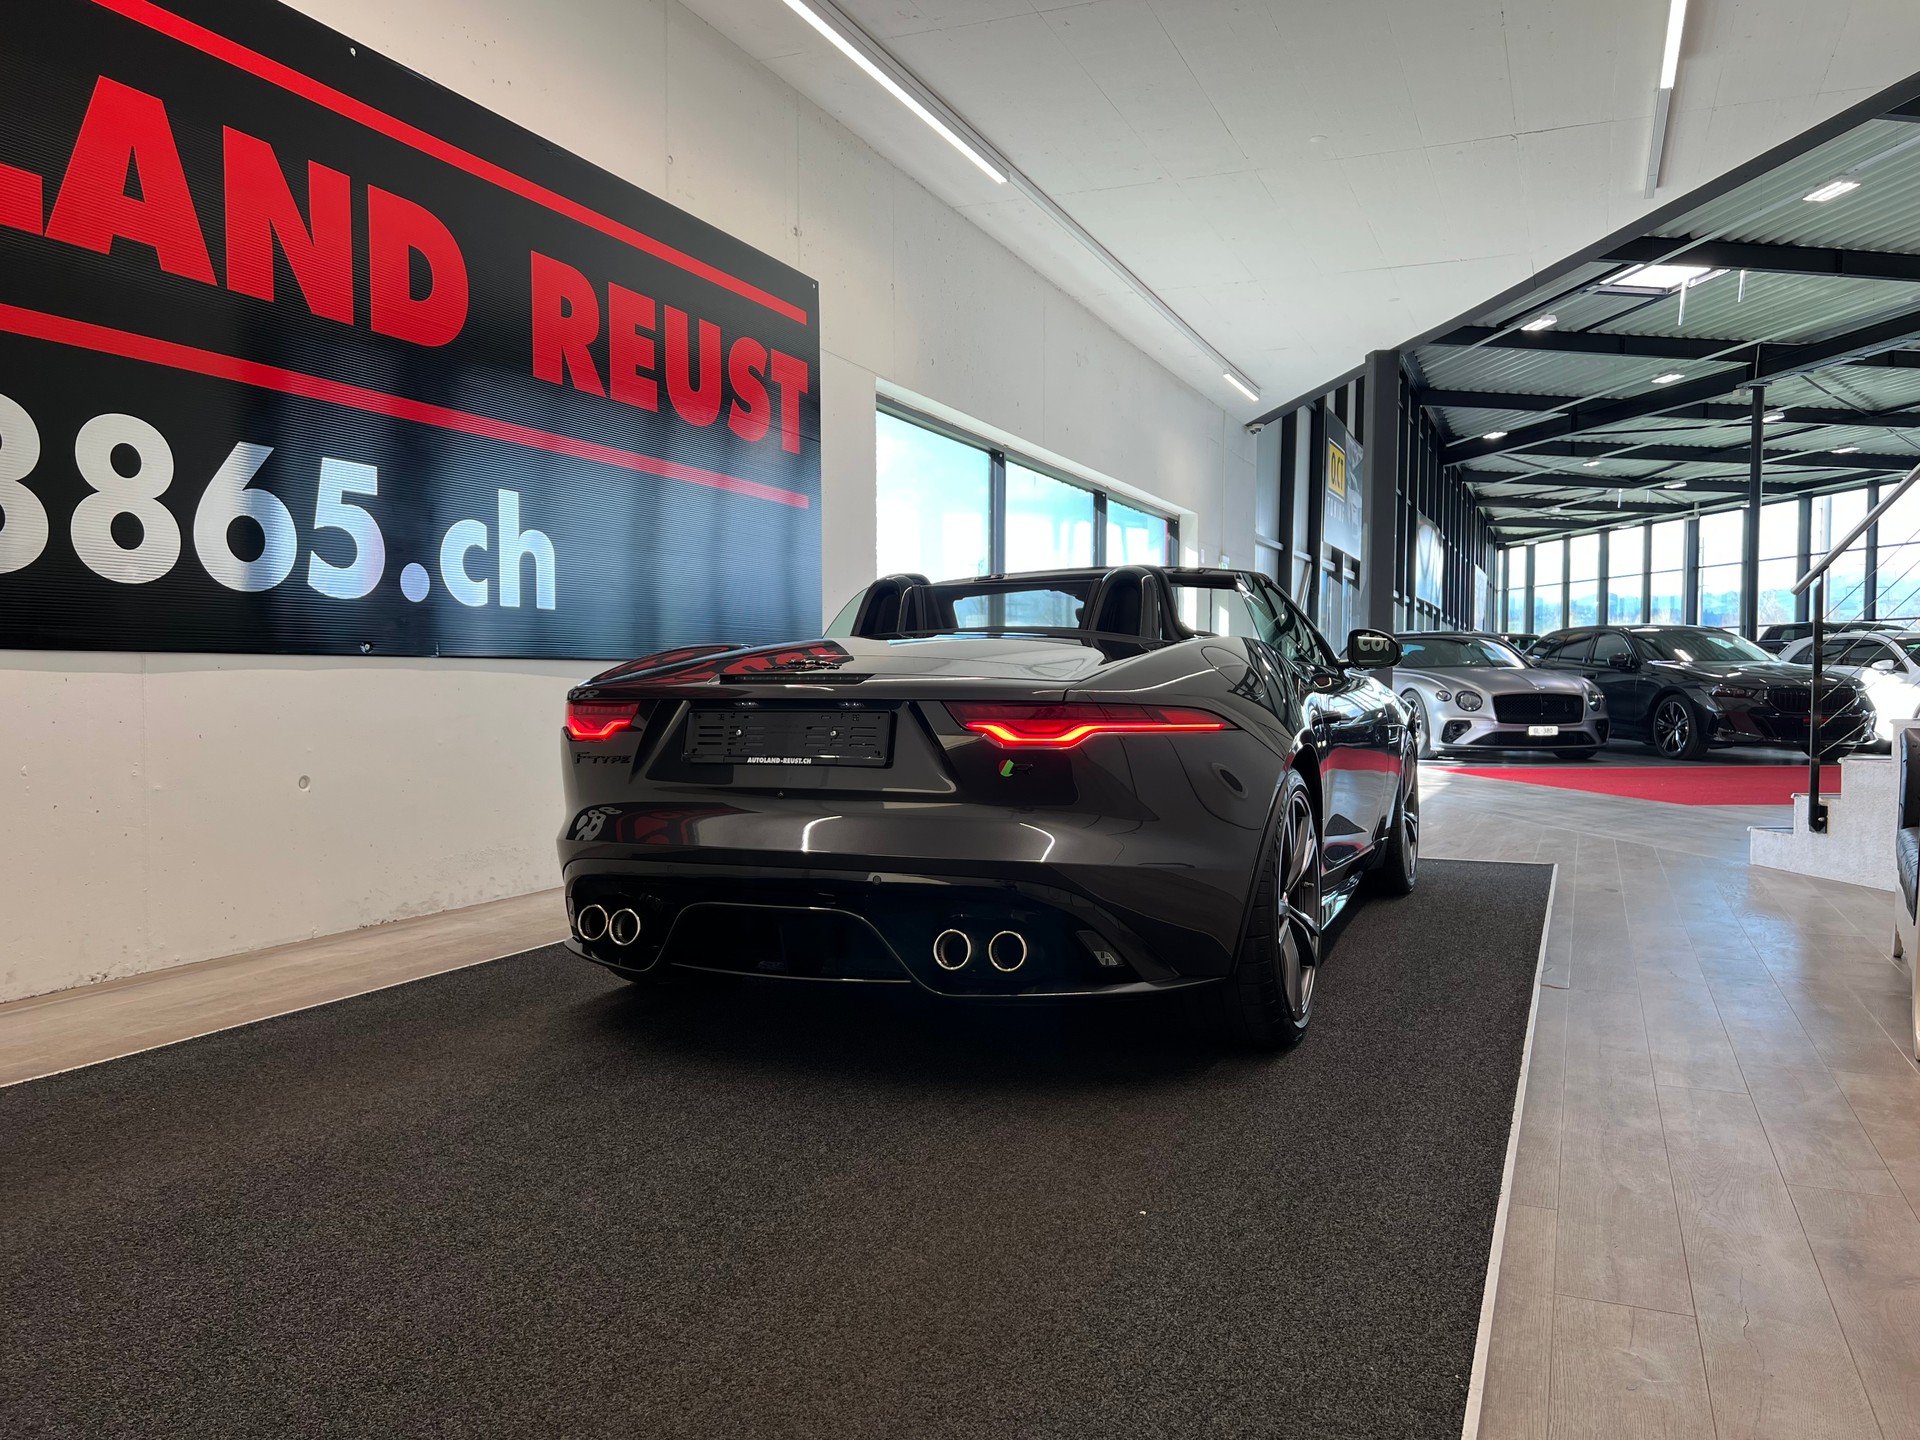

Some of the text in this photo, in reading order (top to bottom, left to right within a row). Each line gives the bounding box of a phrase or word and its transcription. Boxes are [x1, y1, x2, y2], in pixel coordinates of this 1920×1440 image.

[0, 75, 808, 454] AND REUST
[574, 751, 631, 764] F-TYPE
[747, 756, 812, 764] AUTOLAND-REUST.CH
